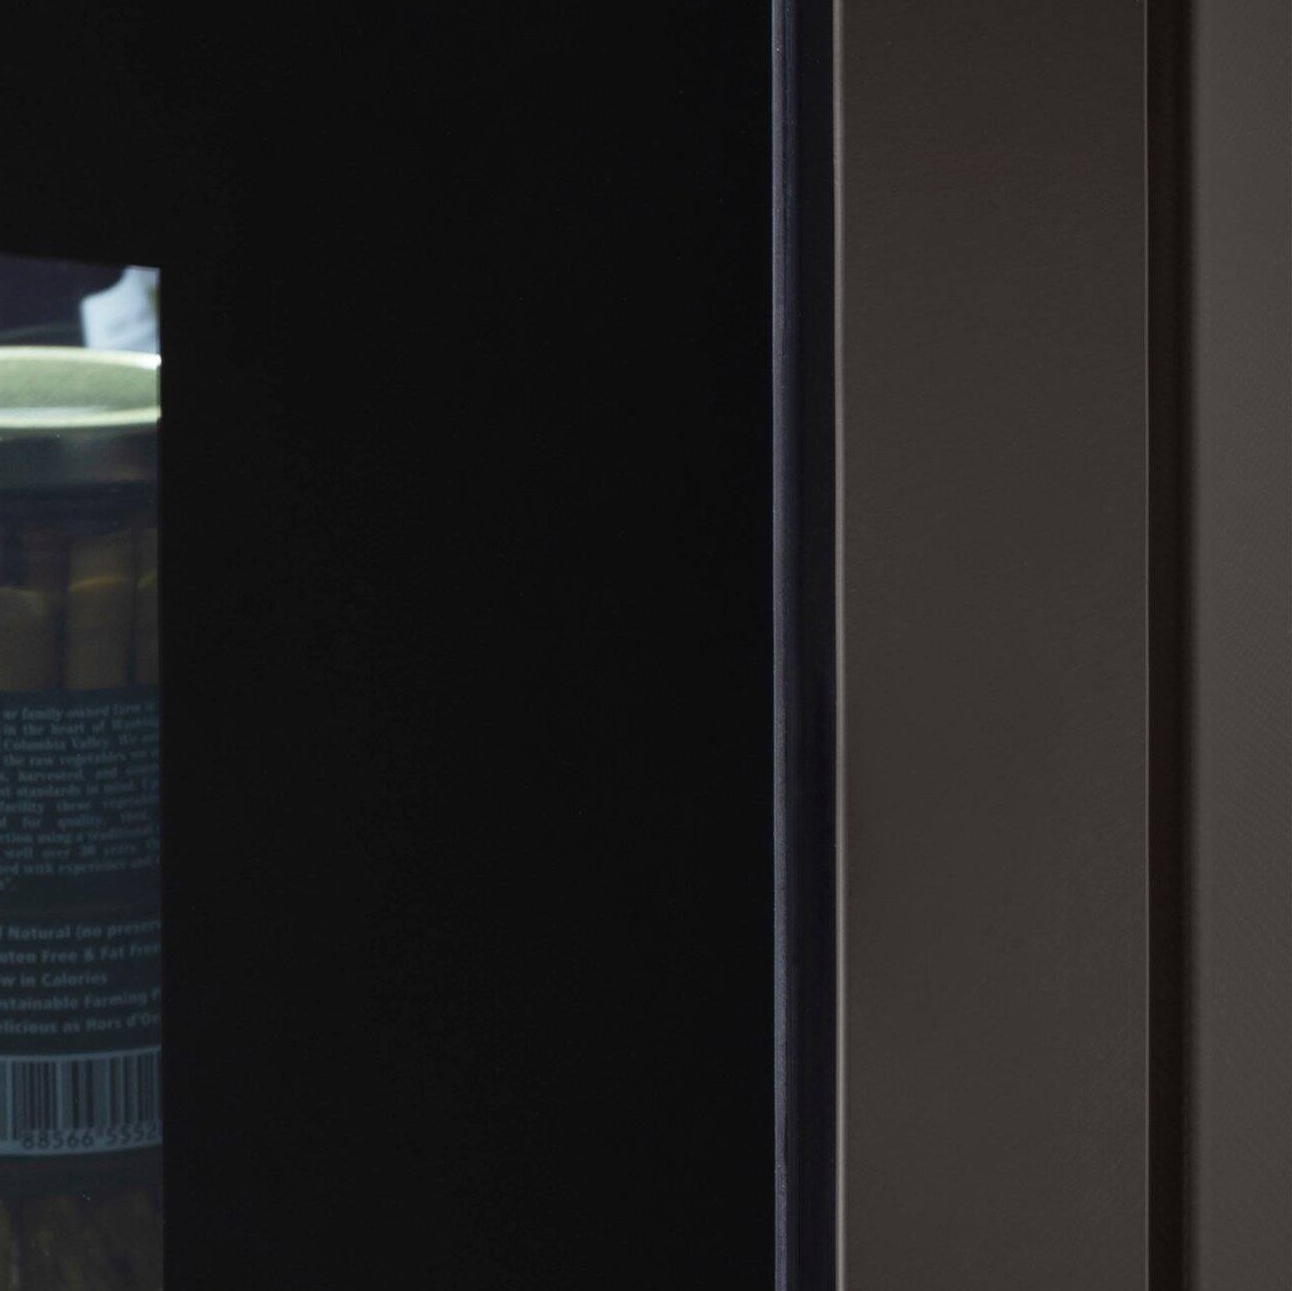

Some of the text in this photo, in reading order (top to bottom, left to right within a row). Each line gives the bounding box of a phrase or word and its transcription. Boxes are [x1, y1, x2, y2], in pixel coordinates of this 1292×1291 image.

[8, 925, 71, 941] Natural
[41, 949, 78, 964] Free
[19, 972, 36, 988] in
[41, 972, 108, 988] Calories
